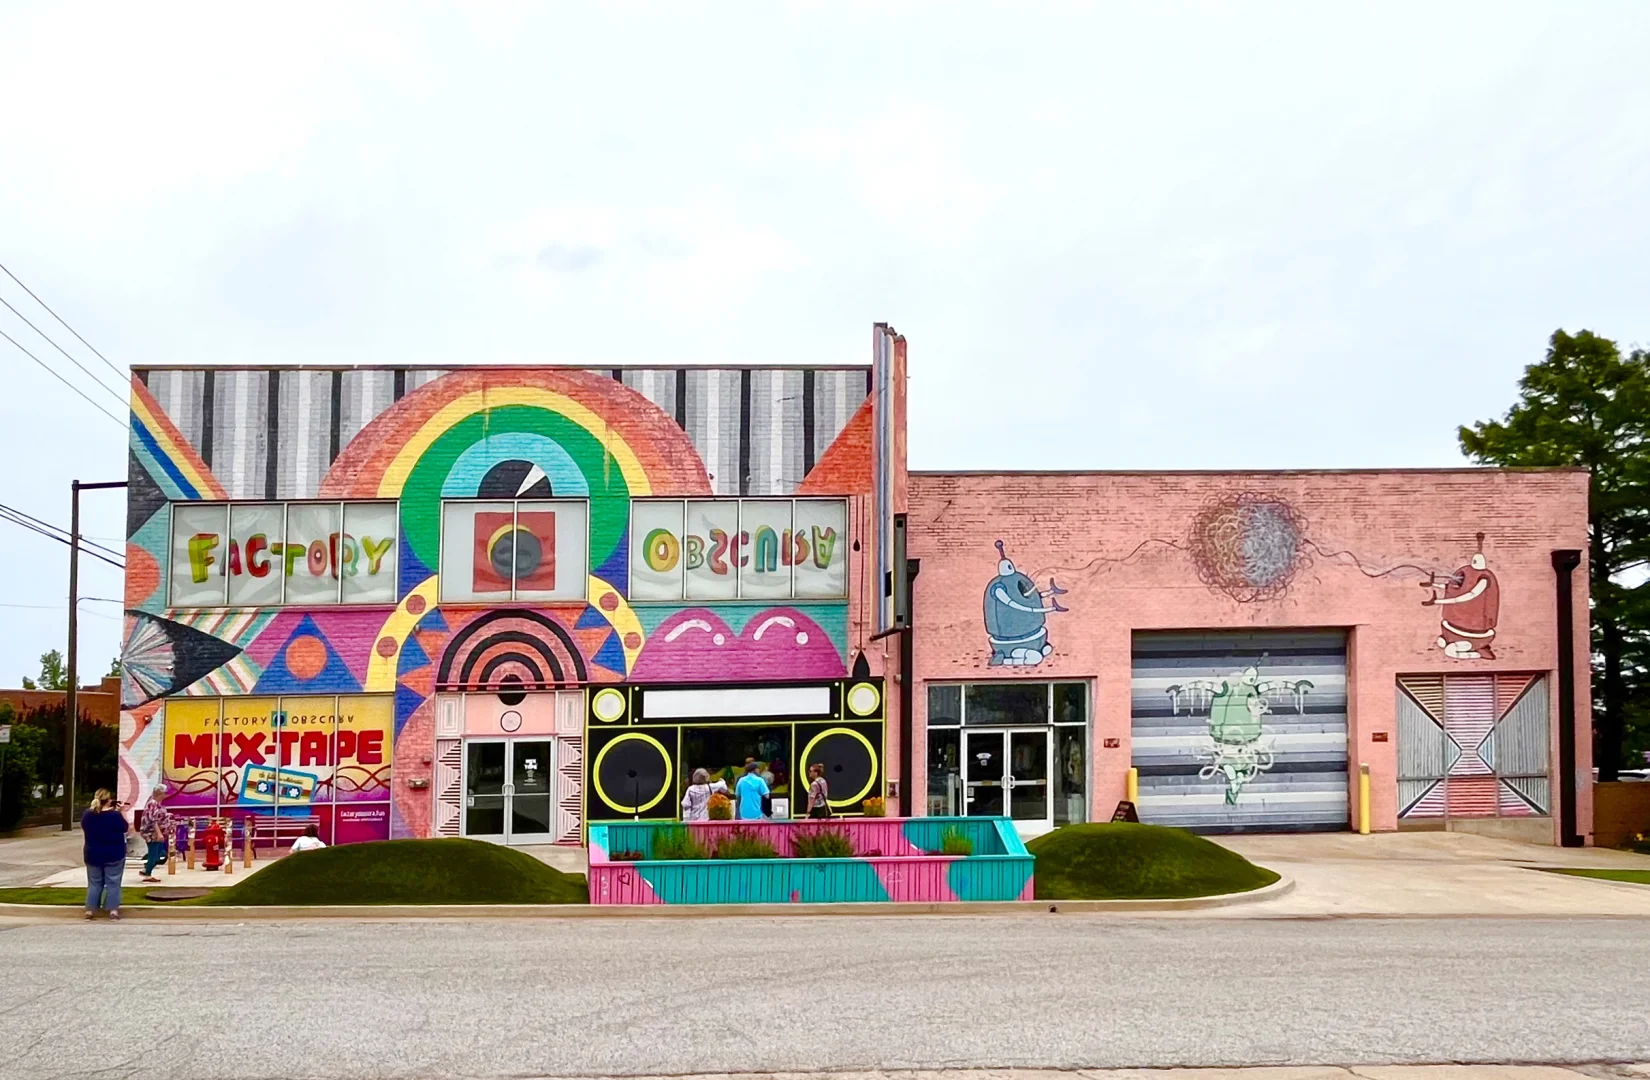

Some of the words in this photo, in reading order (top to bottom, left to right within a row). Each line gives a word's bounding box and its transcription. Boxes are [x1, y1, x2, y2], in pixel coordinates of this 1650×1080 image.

[188, 532, 394, 583] FACTORY
[204, 716, 268, 727] FACTORY
[174, 729, 384, 769] MIX-TAPE
